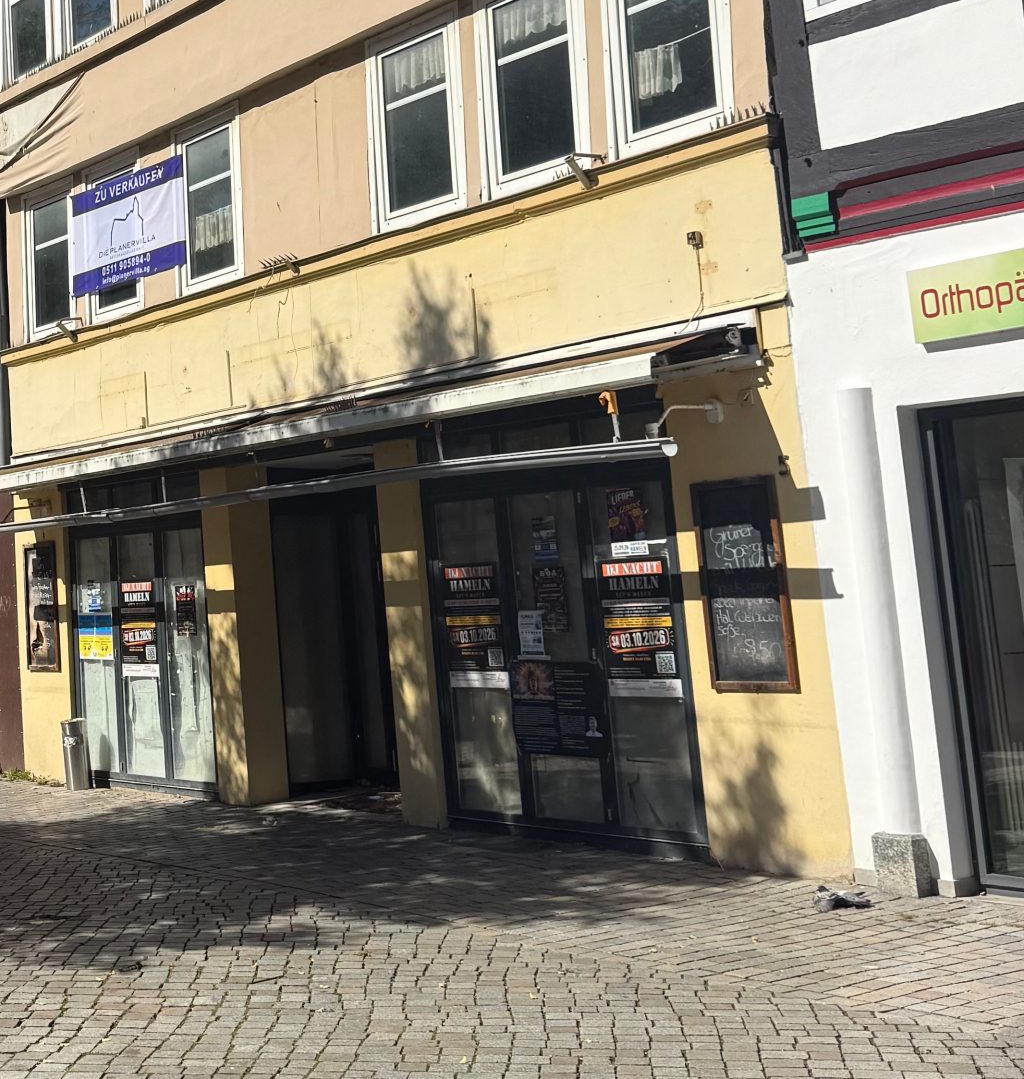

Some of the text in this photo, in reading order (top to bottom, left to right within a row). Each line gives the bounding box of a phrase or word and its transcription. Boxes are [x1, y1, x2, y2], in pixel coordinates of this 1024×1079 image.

[94, 166, 164, 204] ZU VERKAUFEN
[102, 263, 117, 276] 0511
[448, 568, 458, 578] DJ
[606, 561, 657, 576] DJ NACHT
[450, 578, 491, 592] HAMELN
[609, 576, 659, 591] HAMELN
[124, 592, 150, 603] HAMELN
[459, 628, 496, 644] 03.10.2026
[611, 629, 666, 648] SA 03.10.2026
